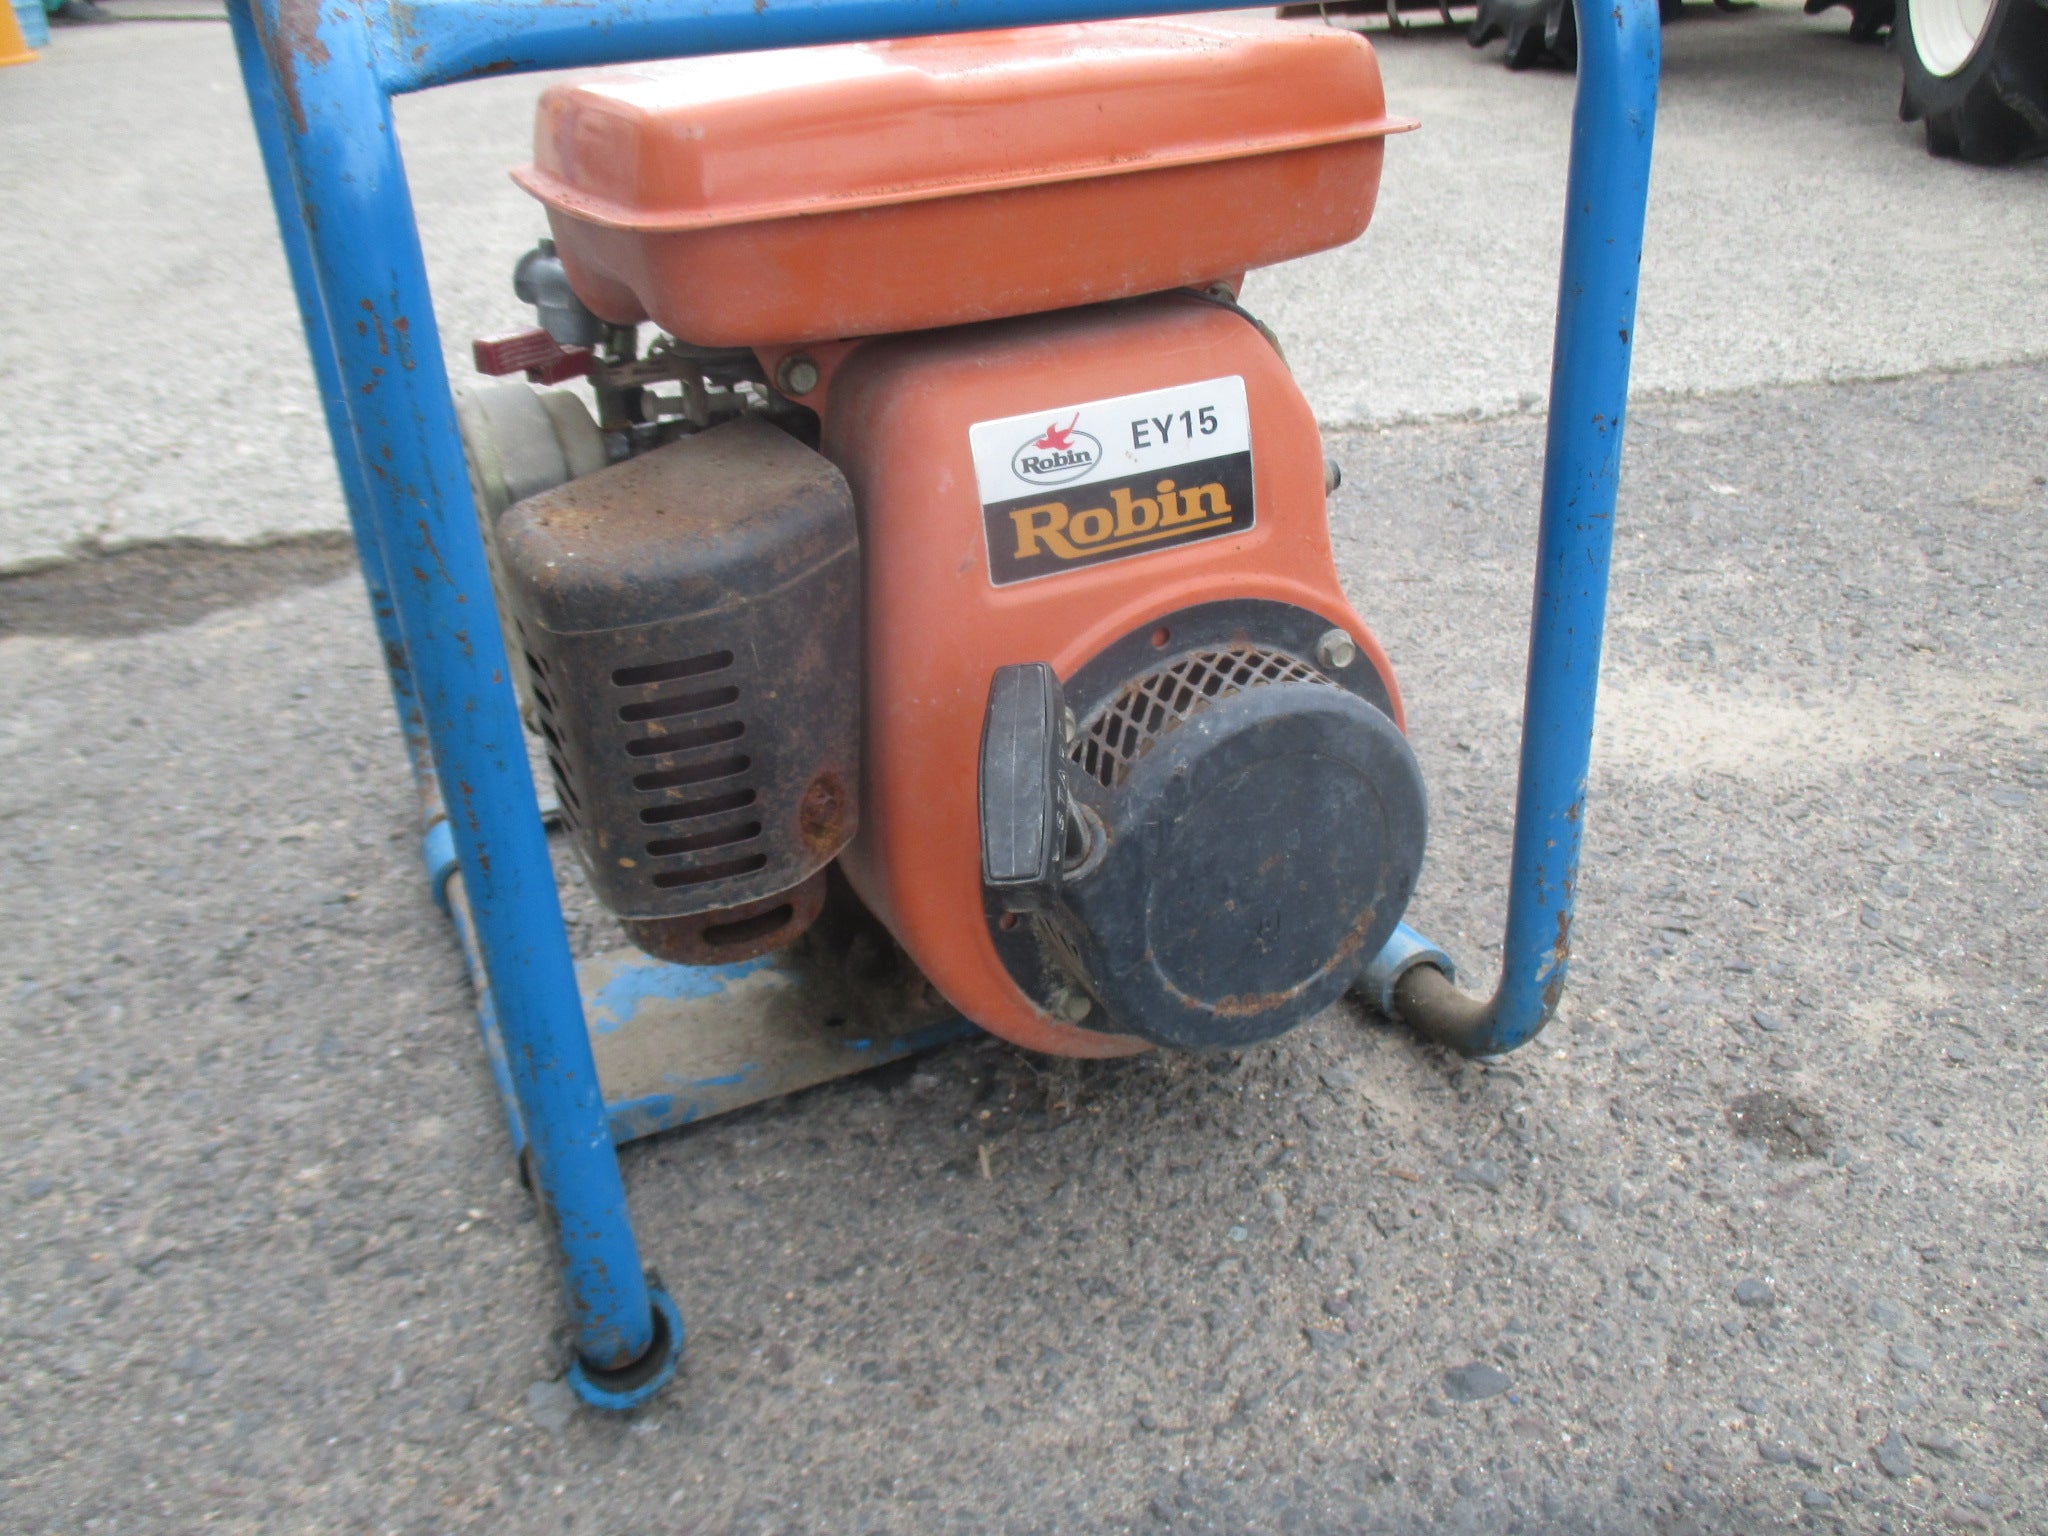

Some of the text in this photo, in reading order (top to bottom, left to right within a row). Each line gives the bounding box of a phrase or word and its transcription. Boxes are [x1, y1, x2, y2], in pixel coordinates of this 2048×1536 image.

[1131, 406, 1218, 449] EY15
[1021, 450, 1093, 475] Robin
[1010, 479, 1233, 559] Robin
